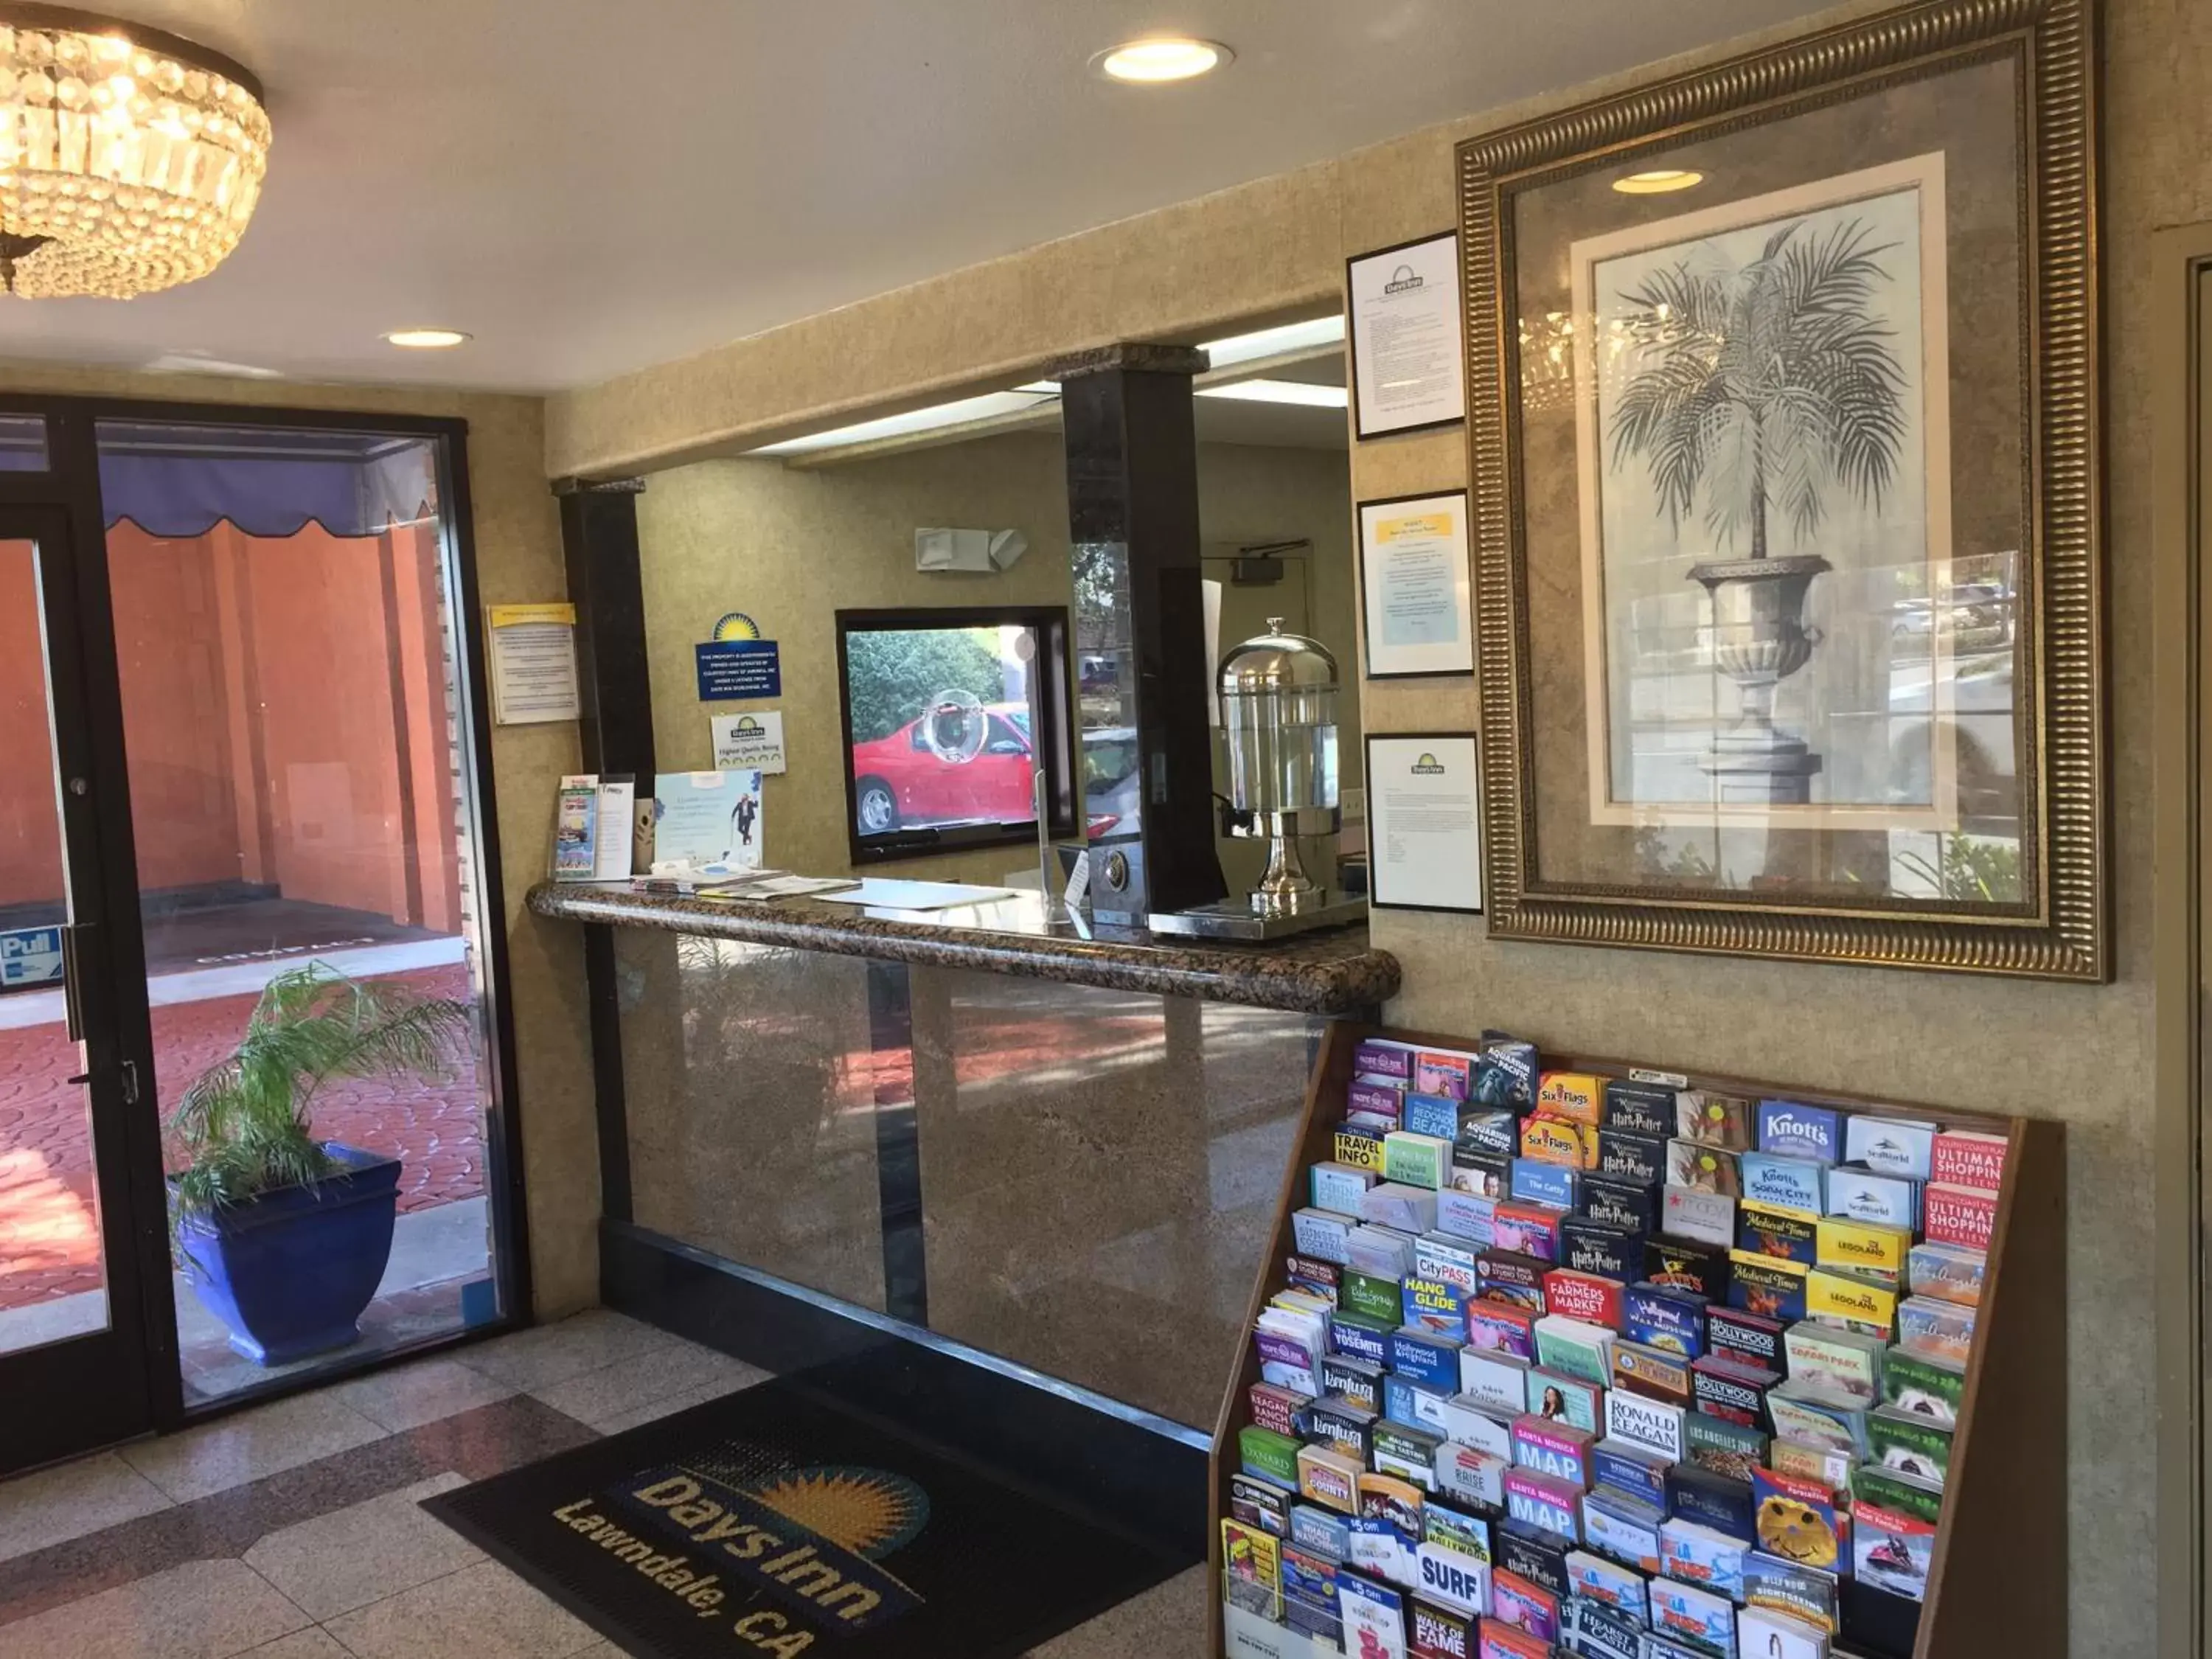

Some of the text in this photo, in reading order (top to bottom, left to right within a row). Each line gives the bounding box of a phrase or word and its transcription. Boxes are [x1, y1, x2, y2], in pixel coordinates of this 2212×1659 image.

[2, 932, 52, 958] Pull
[1487, 1046, 1530, 1072] AQUARIUM
[1498, 1059, 1529, 1081] PACIFIC
[1542, 1090, 1588, 1105] Six Flags
[1413, 1108, 1457, 1126] REDONDO
[1412, 1117, 1458, 1141] BEACH
[1466, 1121, 1511, 1144] AQUARIUM
[1767, 1113, 1829, 1147] Knott's
[1337, 1135, 1380, 1155] TRAVEL
[1478, 1133, 1511, 1152] PACIFIC
[1528, 1134, 1573, 1151] Six Flags
[1338, 1148, 1371, 1165] INFO
[1867, 1149, 1910, 1165] SeaWorld
[1937, 1148, 2004, 1168] ULTIMAT
[1937, 1161, 2002, 1180] SHOPPIN
[1528, 1180, 1543, 1190] The
[1848, 1202, 1890, 1217] SeaWorld
[1930, 1201, 1995, 1224] ULTIMAT
[1930, 1213, 1993, 1235] SHOPPIN
[1837, 1240, 1885, 1259] LEGOLAND
[1419, 1260, 1472, 1285] CityPASS
[1405, 1279, 1445, 1296] HANG
[1550, 1283, 1604, 1302] FARMERS
[1415, 1294, 1458, 1312] GLIDE
[1554, 1296, 1604, 1313] MARKET
[1831, 1293, 1878, 1313] LEGOLAND
[1334, 1332, 1384, 1356] YOSEMITE
[1710, 1321, 1775, 1349] HOLLYWOOD
[1324, 1368, 1374, 1405] Ventura
[1694, 1377, 1758, 1405] HOLLYWOOD
[1611, 1400, 1675, 1432] RONALD
[1312, 1414, 1362, 1450] Ventura
[1517, 1429, 1543, 1444] SANTA
[1611, 1413, 1676, 1448] REAGAN
[1242, 1444, 1290, 1470] OXNARD
[1520, 1442, 1578, 1480] MAP
[1310, 1479, 1349, 1501] COUNTY
[1512, 1495, 1571, 1534] MAP
[631, 1474, 882, 1621] Days Inn
[552, 1498, 815, 1659] Lawndale, CA
[1422, 1556, 1478, 1601] SURF
[1416, 1613, 1447, 1635] WALK
[1416, 1624, 1466, 1659] FAME
